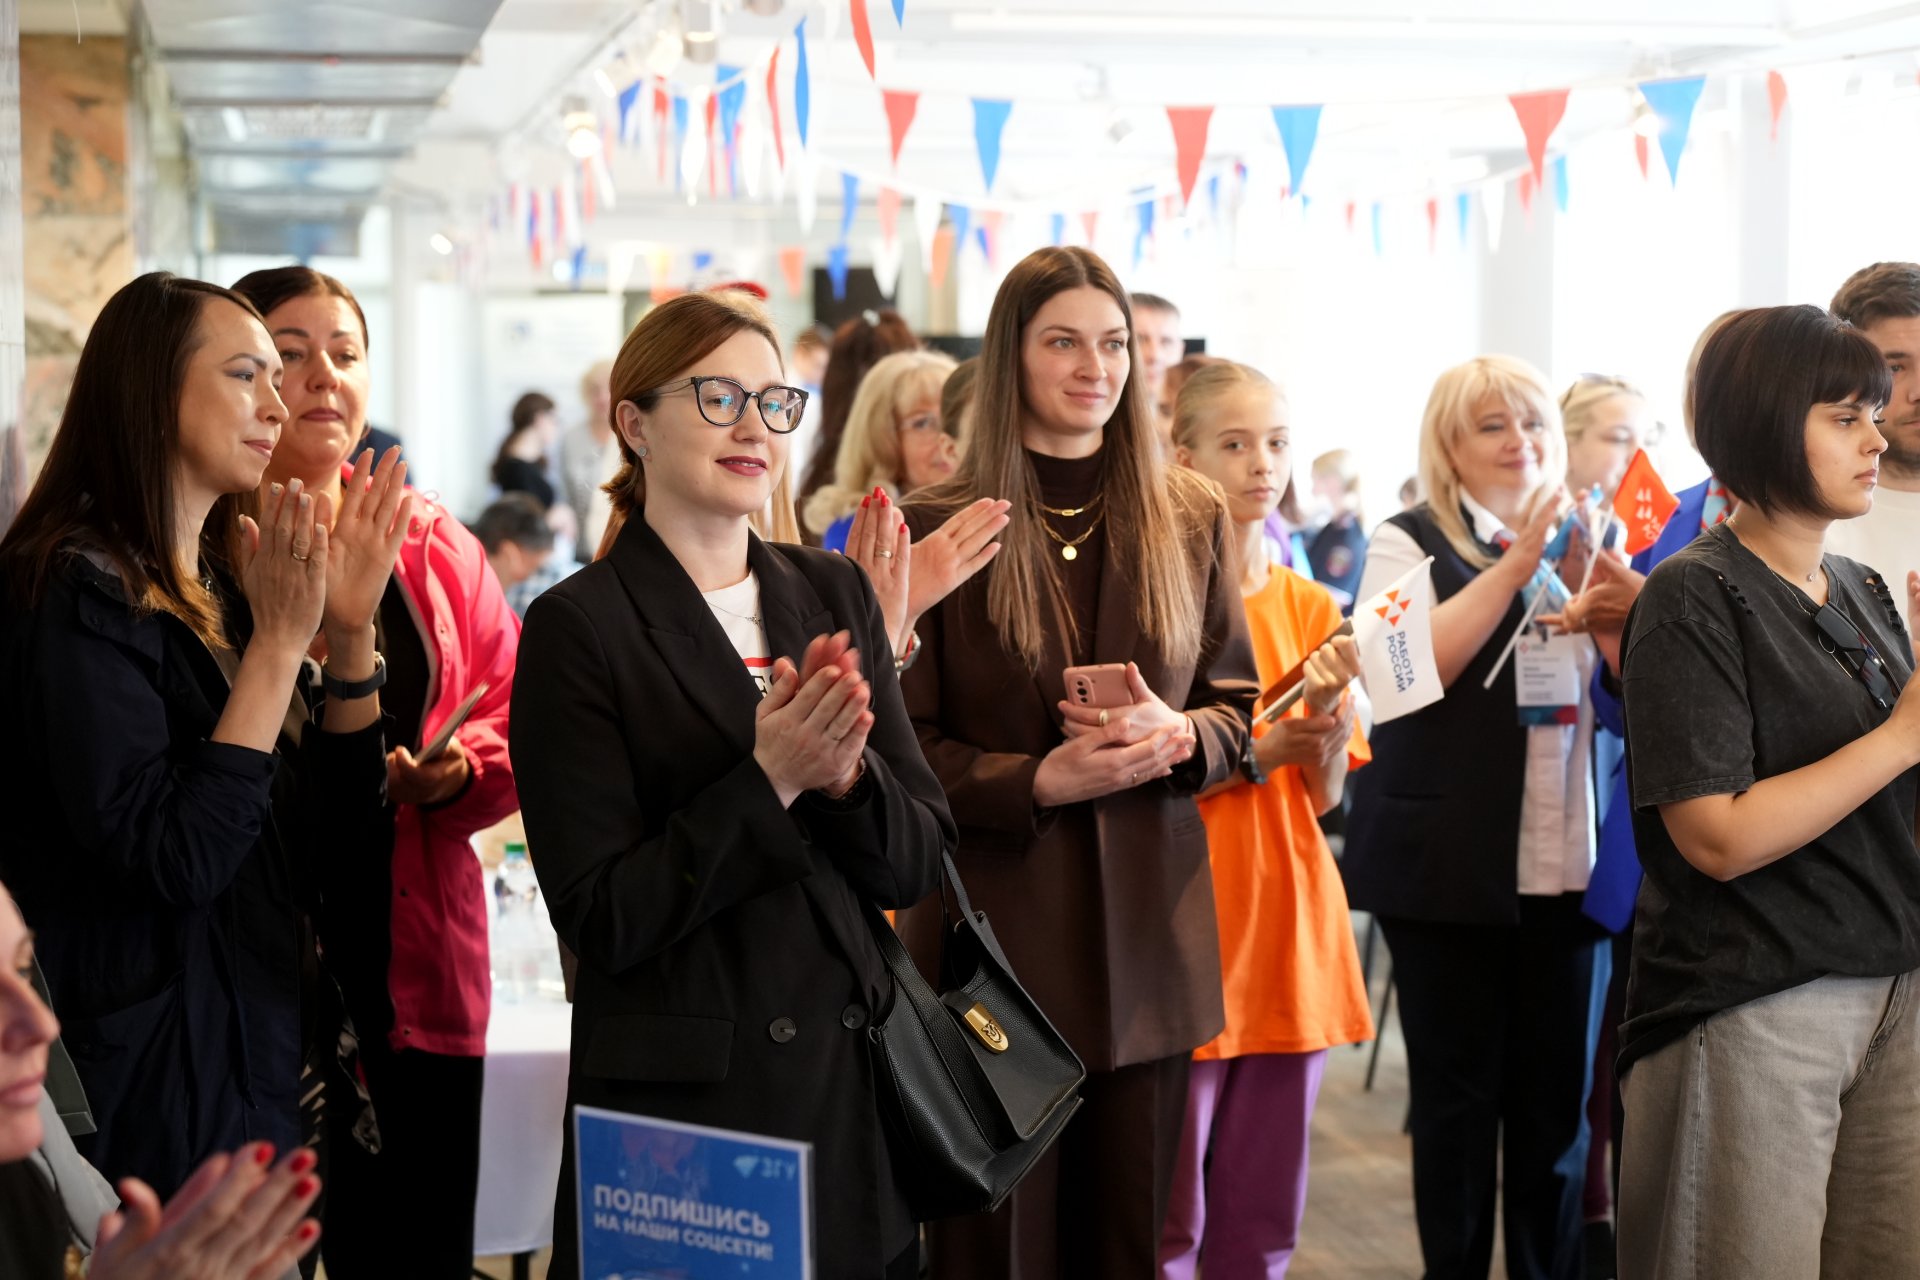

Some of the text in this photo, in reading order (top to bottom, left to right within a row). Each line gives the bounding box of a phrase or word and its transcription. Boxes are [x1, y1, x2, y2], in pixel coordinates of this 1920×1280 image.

[1386, 635, 1406, 693] РОССИИ
[1397, 631, 1415, 687] РАБОТА
[594, 1184, 770, 1238] ПОДПИШИСЬ
[594, 1212, 621, 1232] НА
[623, 1218, 680, 1243] НАШИ
